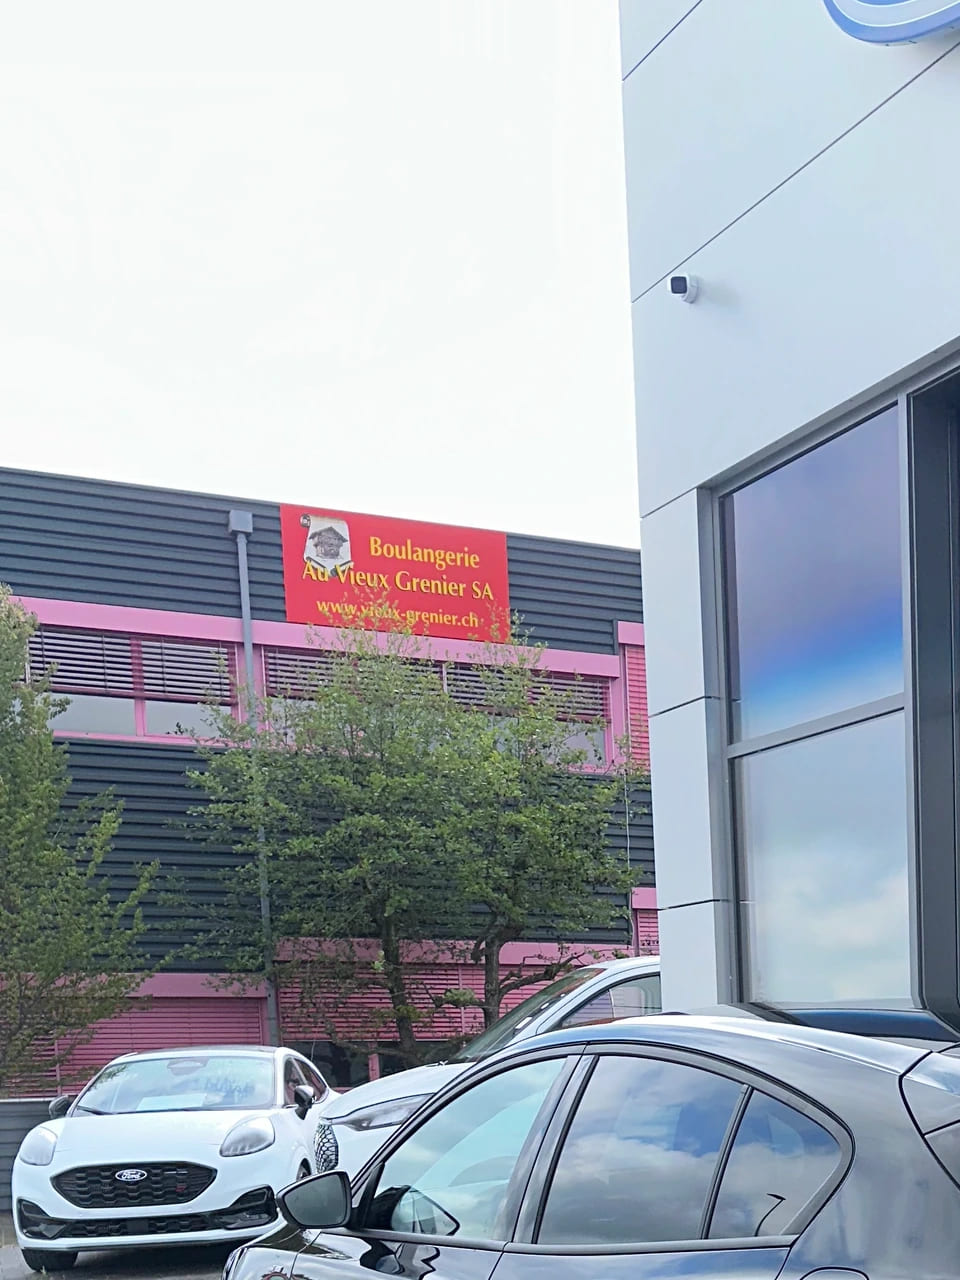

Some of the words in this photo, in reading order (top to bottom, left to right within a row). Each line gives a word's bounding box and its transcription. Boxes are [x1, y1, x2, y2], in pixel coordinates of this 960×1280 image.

[369, 536, 480, 571] Boulangerie
[302, 561, 329, 582] Au
[335, 562, 389, 589] Vieux
[395, 571, 467, 597] Grenier
[472, 581, 495, 601] SA
